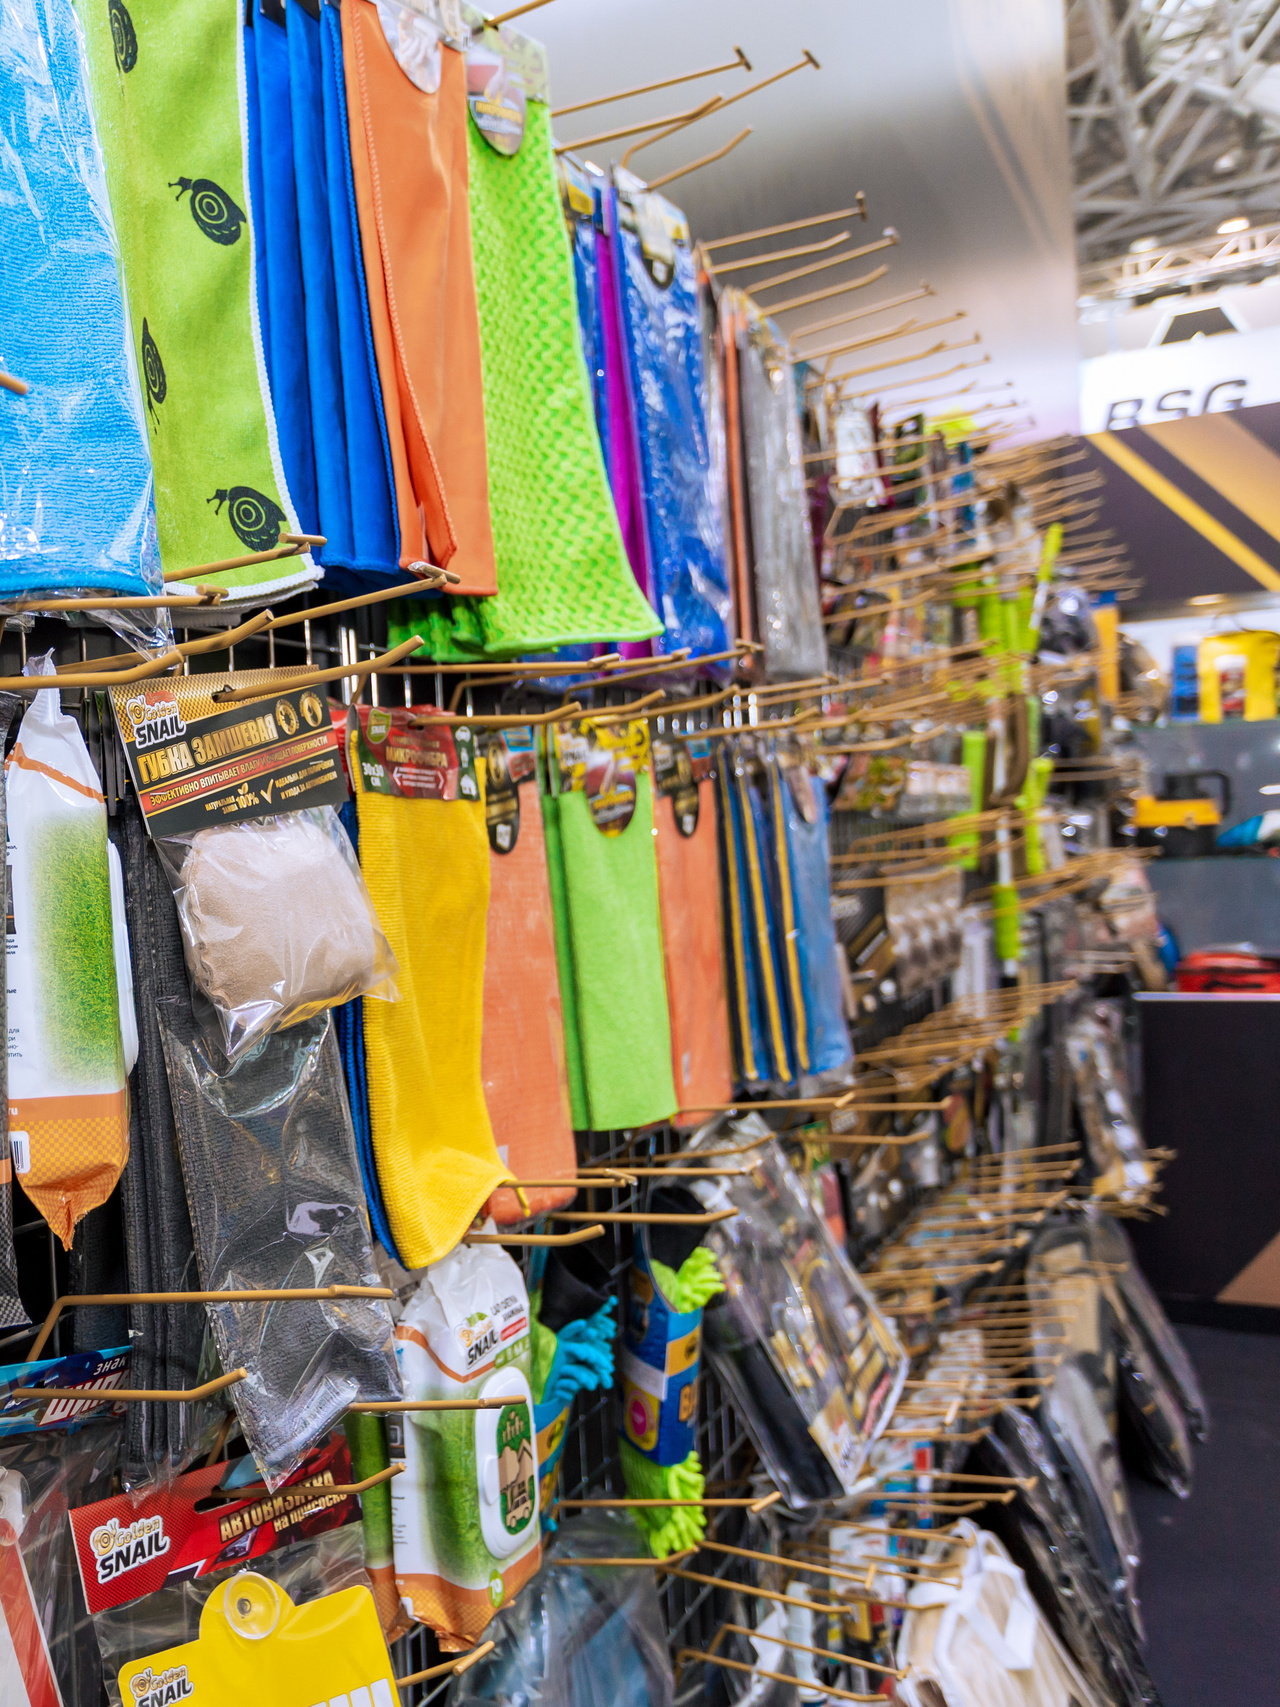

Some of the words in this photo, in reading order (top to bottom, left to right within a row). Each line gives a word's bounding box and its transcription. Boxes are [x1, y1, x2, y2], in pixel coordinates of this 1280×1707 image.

[145, 703, 178, 721] Golden
[136, 715, 185, 746] SNAIL
[137, 741, 195, 785] ГУБКА
[191, 713, 279, 765] ЗАМШЕВАЯ
[150, 780, 200, 806] ЭФФЕКТИВНО
[200, 767, 241, 789] ВПИТЫВАЕТ
[240, 759, 261, 774] ВЛАГУ
[236, 791, 260, 809] 100%
[468, 1328, 498, 1367] SNAIL
[116, 1517, 160, 1549] Golden
[273, 1515, 290, 1533] на
[100, 1533, 170, 1581] SNAIL
[151, 1667, 186, 1691] Golden
